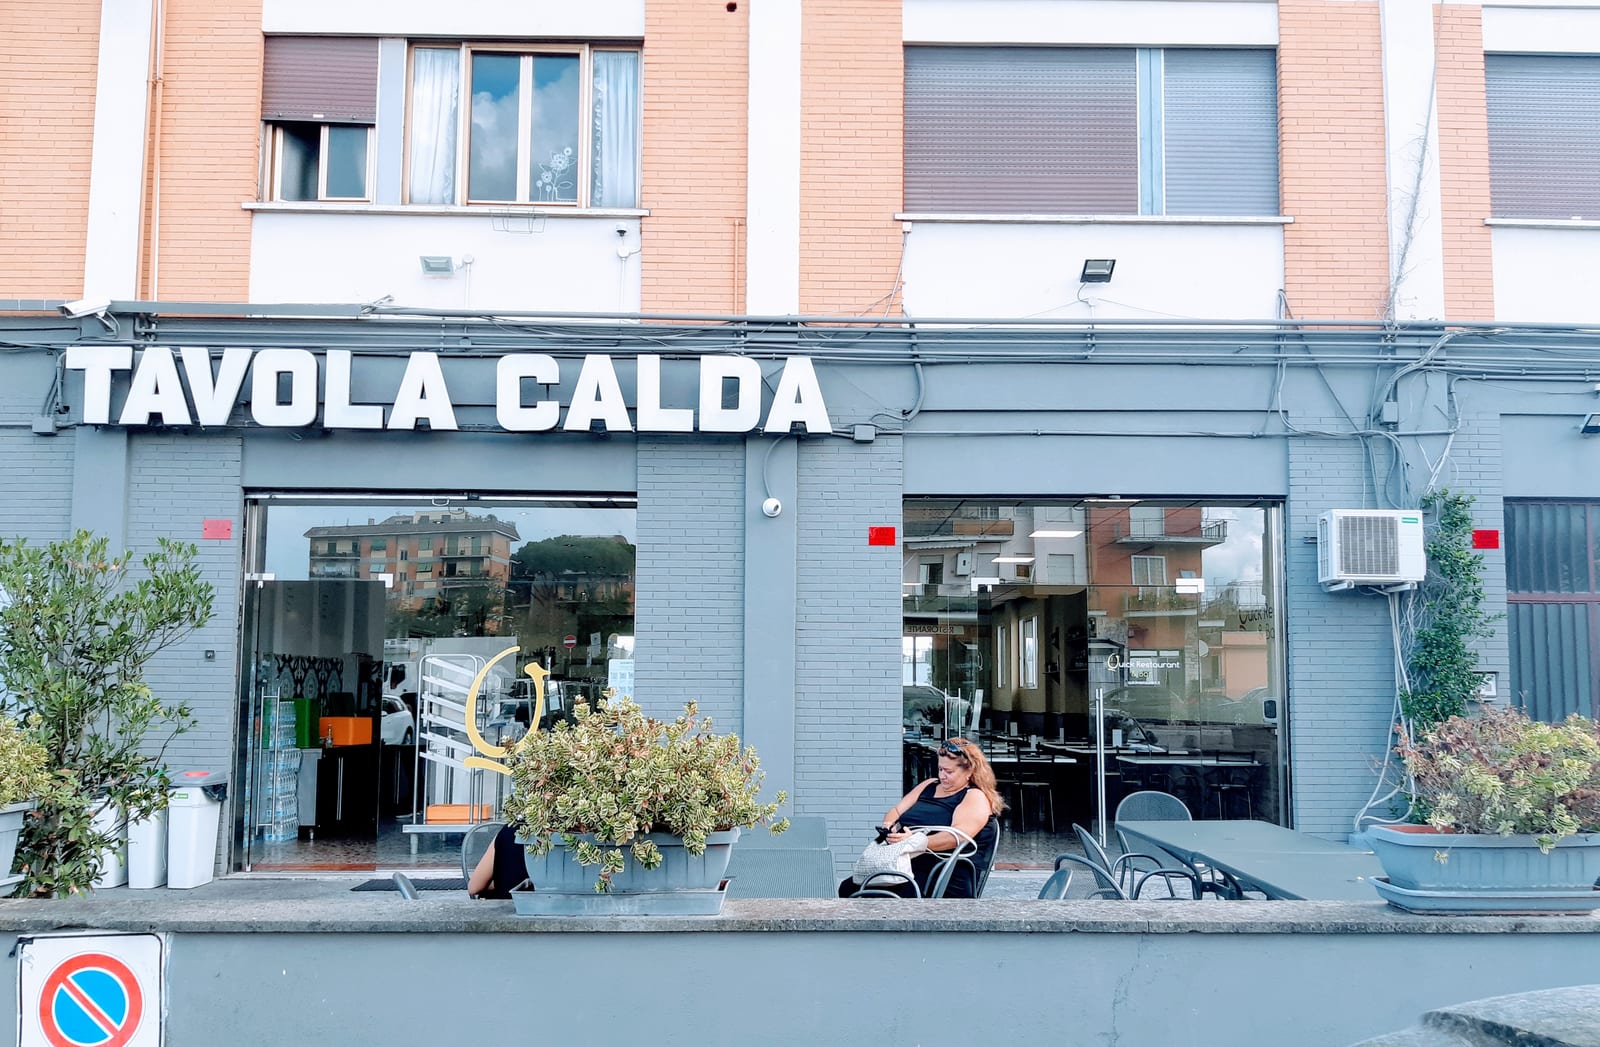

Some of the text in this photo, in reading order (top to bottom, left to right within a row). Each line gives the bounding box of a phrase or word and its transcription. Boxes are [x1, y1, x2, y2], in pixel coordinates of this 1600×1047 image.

[64, 346, 833, 434] TAVOLA CALDA
[1107, 653, 1180, 671] Quick Restaurant
